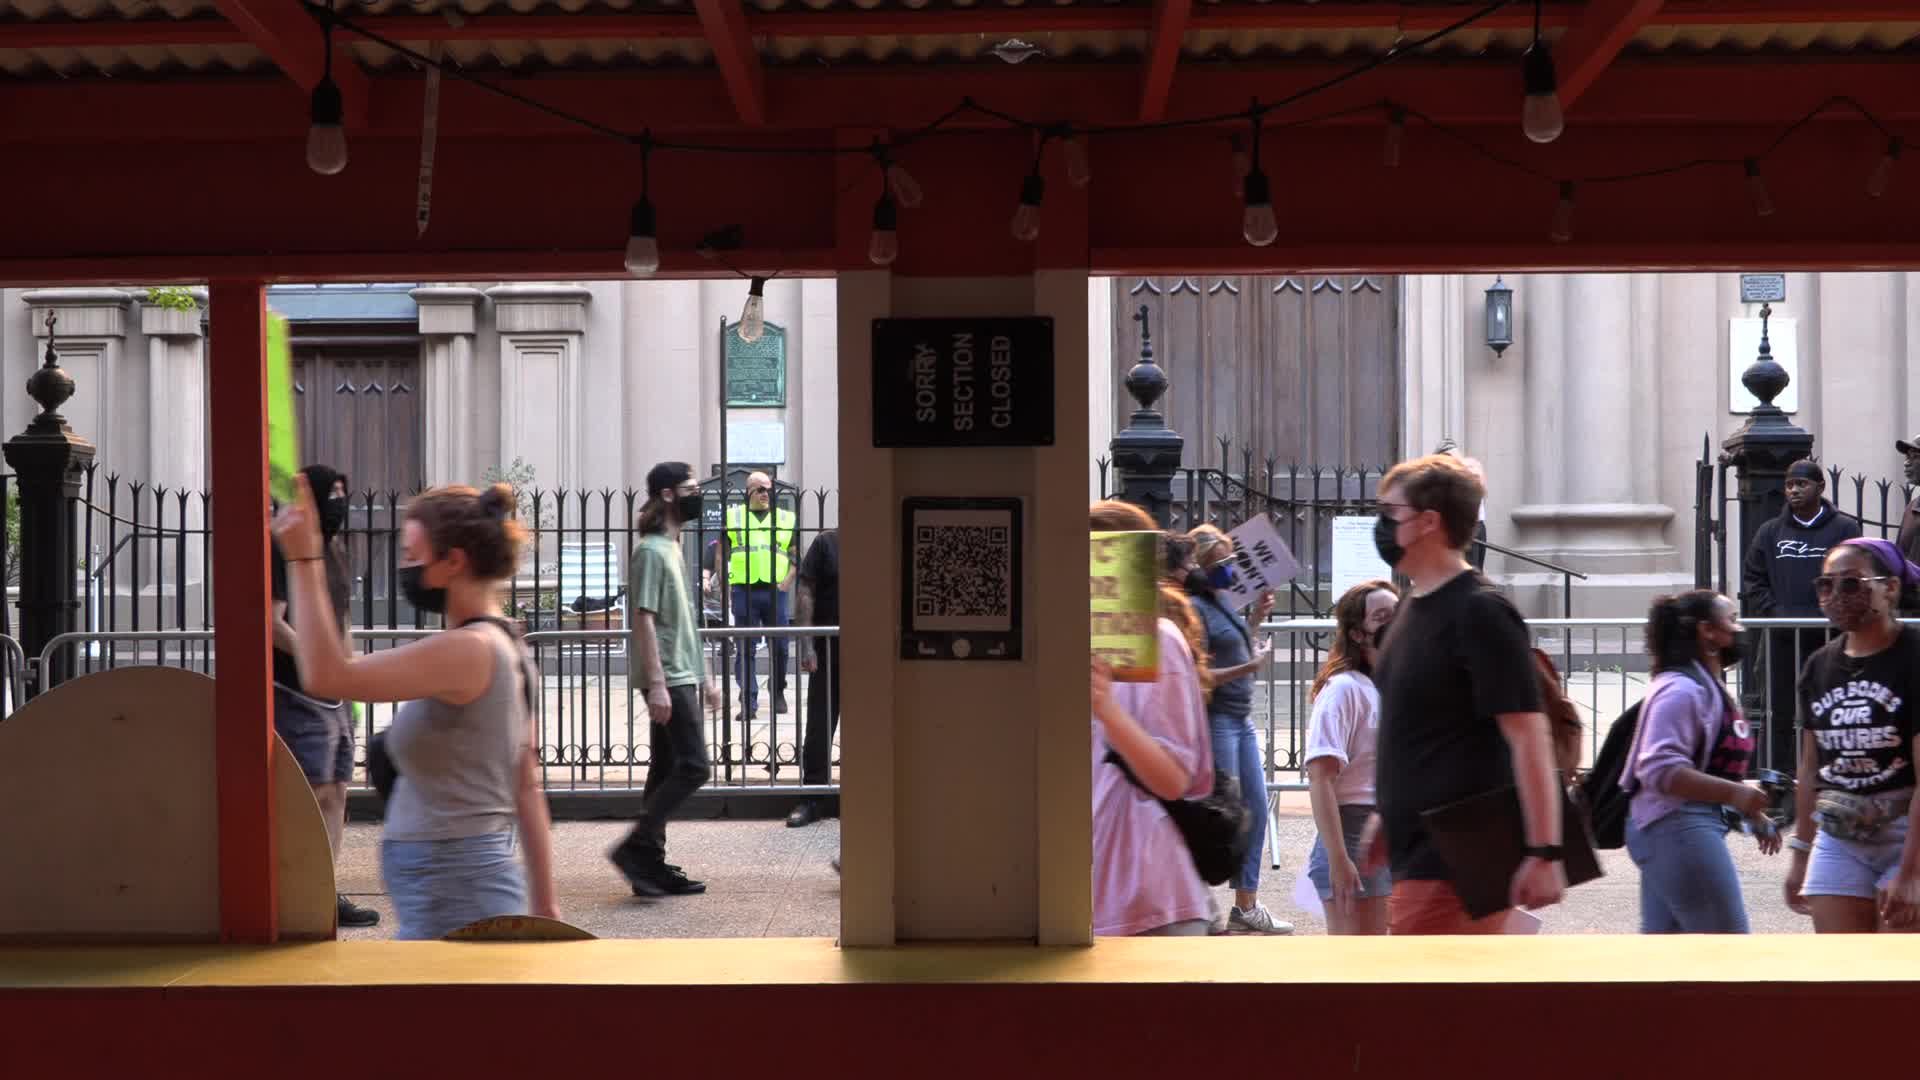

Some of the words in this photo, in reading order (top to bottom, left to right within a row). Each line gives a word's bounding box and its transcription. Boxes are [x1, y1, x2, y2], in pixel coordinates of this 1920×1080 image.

[915, 343, 937, 423] SORRY
[952, 332, 975, 431] SECTION
[991, 335, 1012, 429] CLOSED
[1253, 540, 1277, 568] WE
[1811, 686, 1846, 717] OUR
[1830, 705, 1873, 727] OUR
